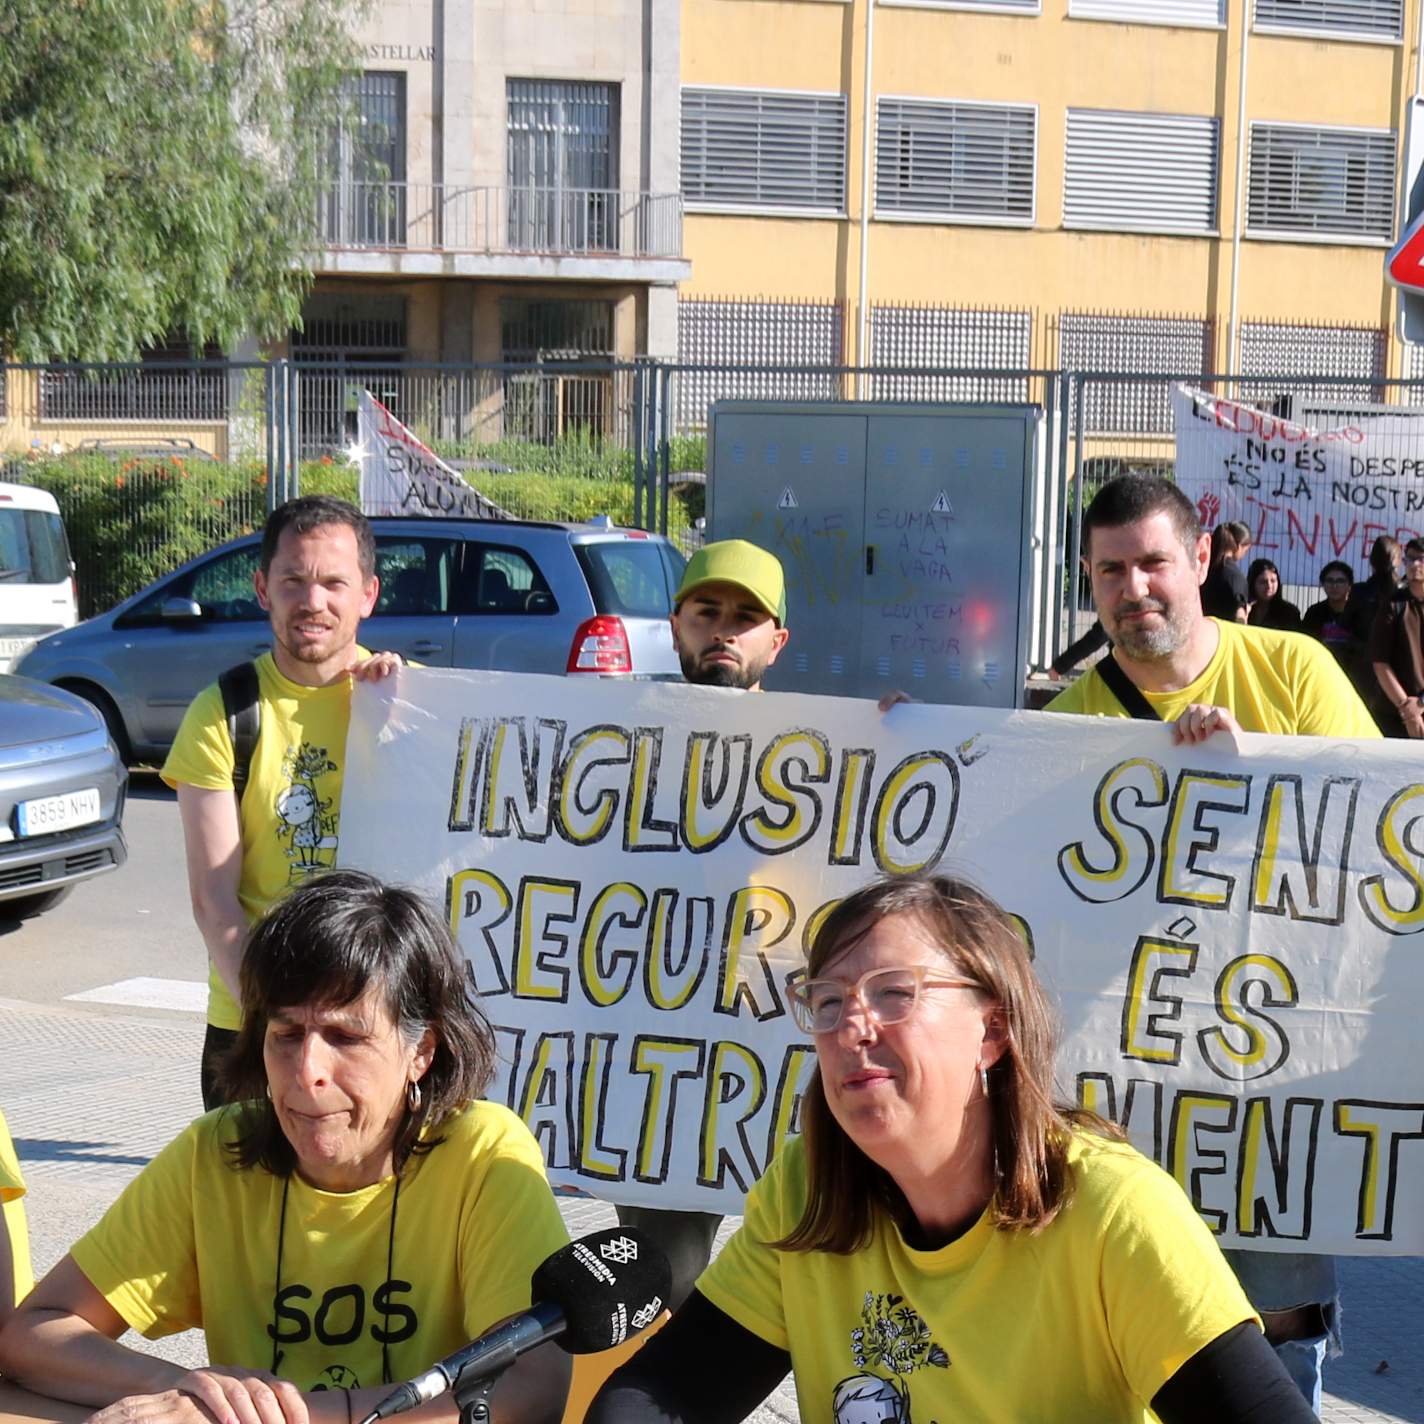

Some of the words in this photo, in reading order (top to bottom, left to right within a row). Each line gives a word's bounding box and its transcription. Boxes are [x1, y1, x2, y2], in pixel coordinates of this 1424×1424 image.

[30, 800, 66, 826] 3859
[70, 795, 96, 819] NHV
[448, 715, 989, 875] INCLUSIÓ
[1121, 914, 1301, 1082] ÉS
[572, 1249, 606, 1283] TELEVISION
[573, 1243, 617, 1287] ATRESMEDIA
[266, 1279, 419, 1346] SOS
